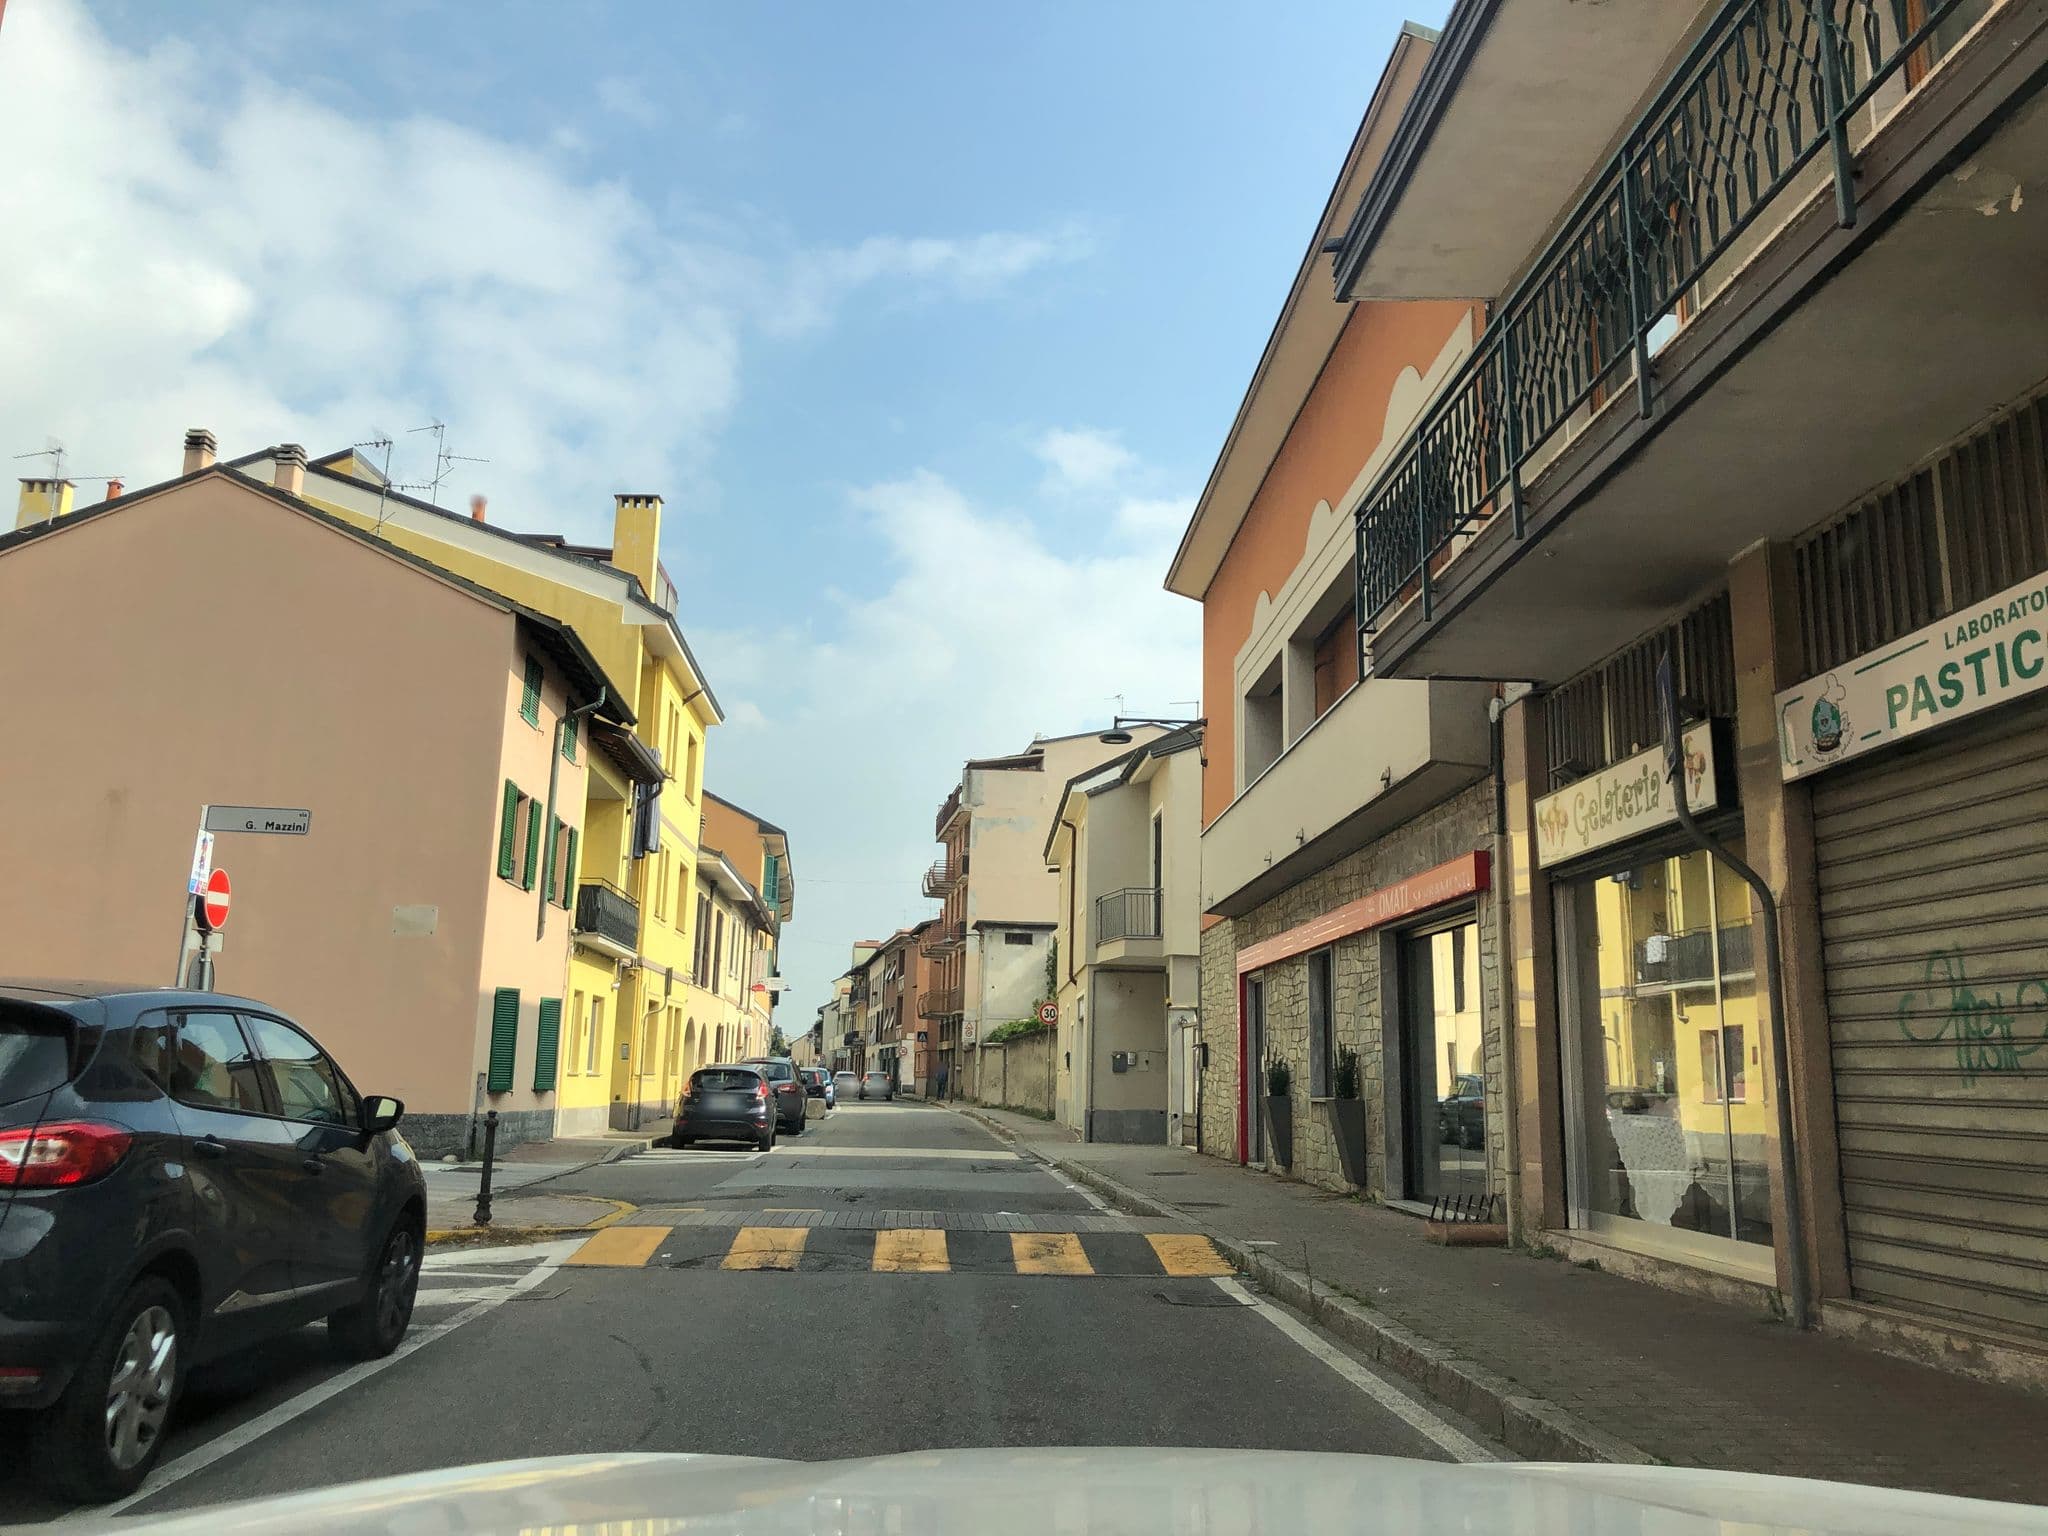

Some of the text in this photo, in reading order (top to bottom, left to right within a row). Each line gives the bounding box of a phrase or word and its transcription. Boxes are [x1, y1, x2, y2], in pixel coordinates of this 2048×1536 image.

[1885, 629, 2048, 729] PASTIC
[245, 820, 306, 832] G. Mazzini
[1573, 763, 1661, 846] Gelateria
[1044, 1008, 1056, 1018] 30
